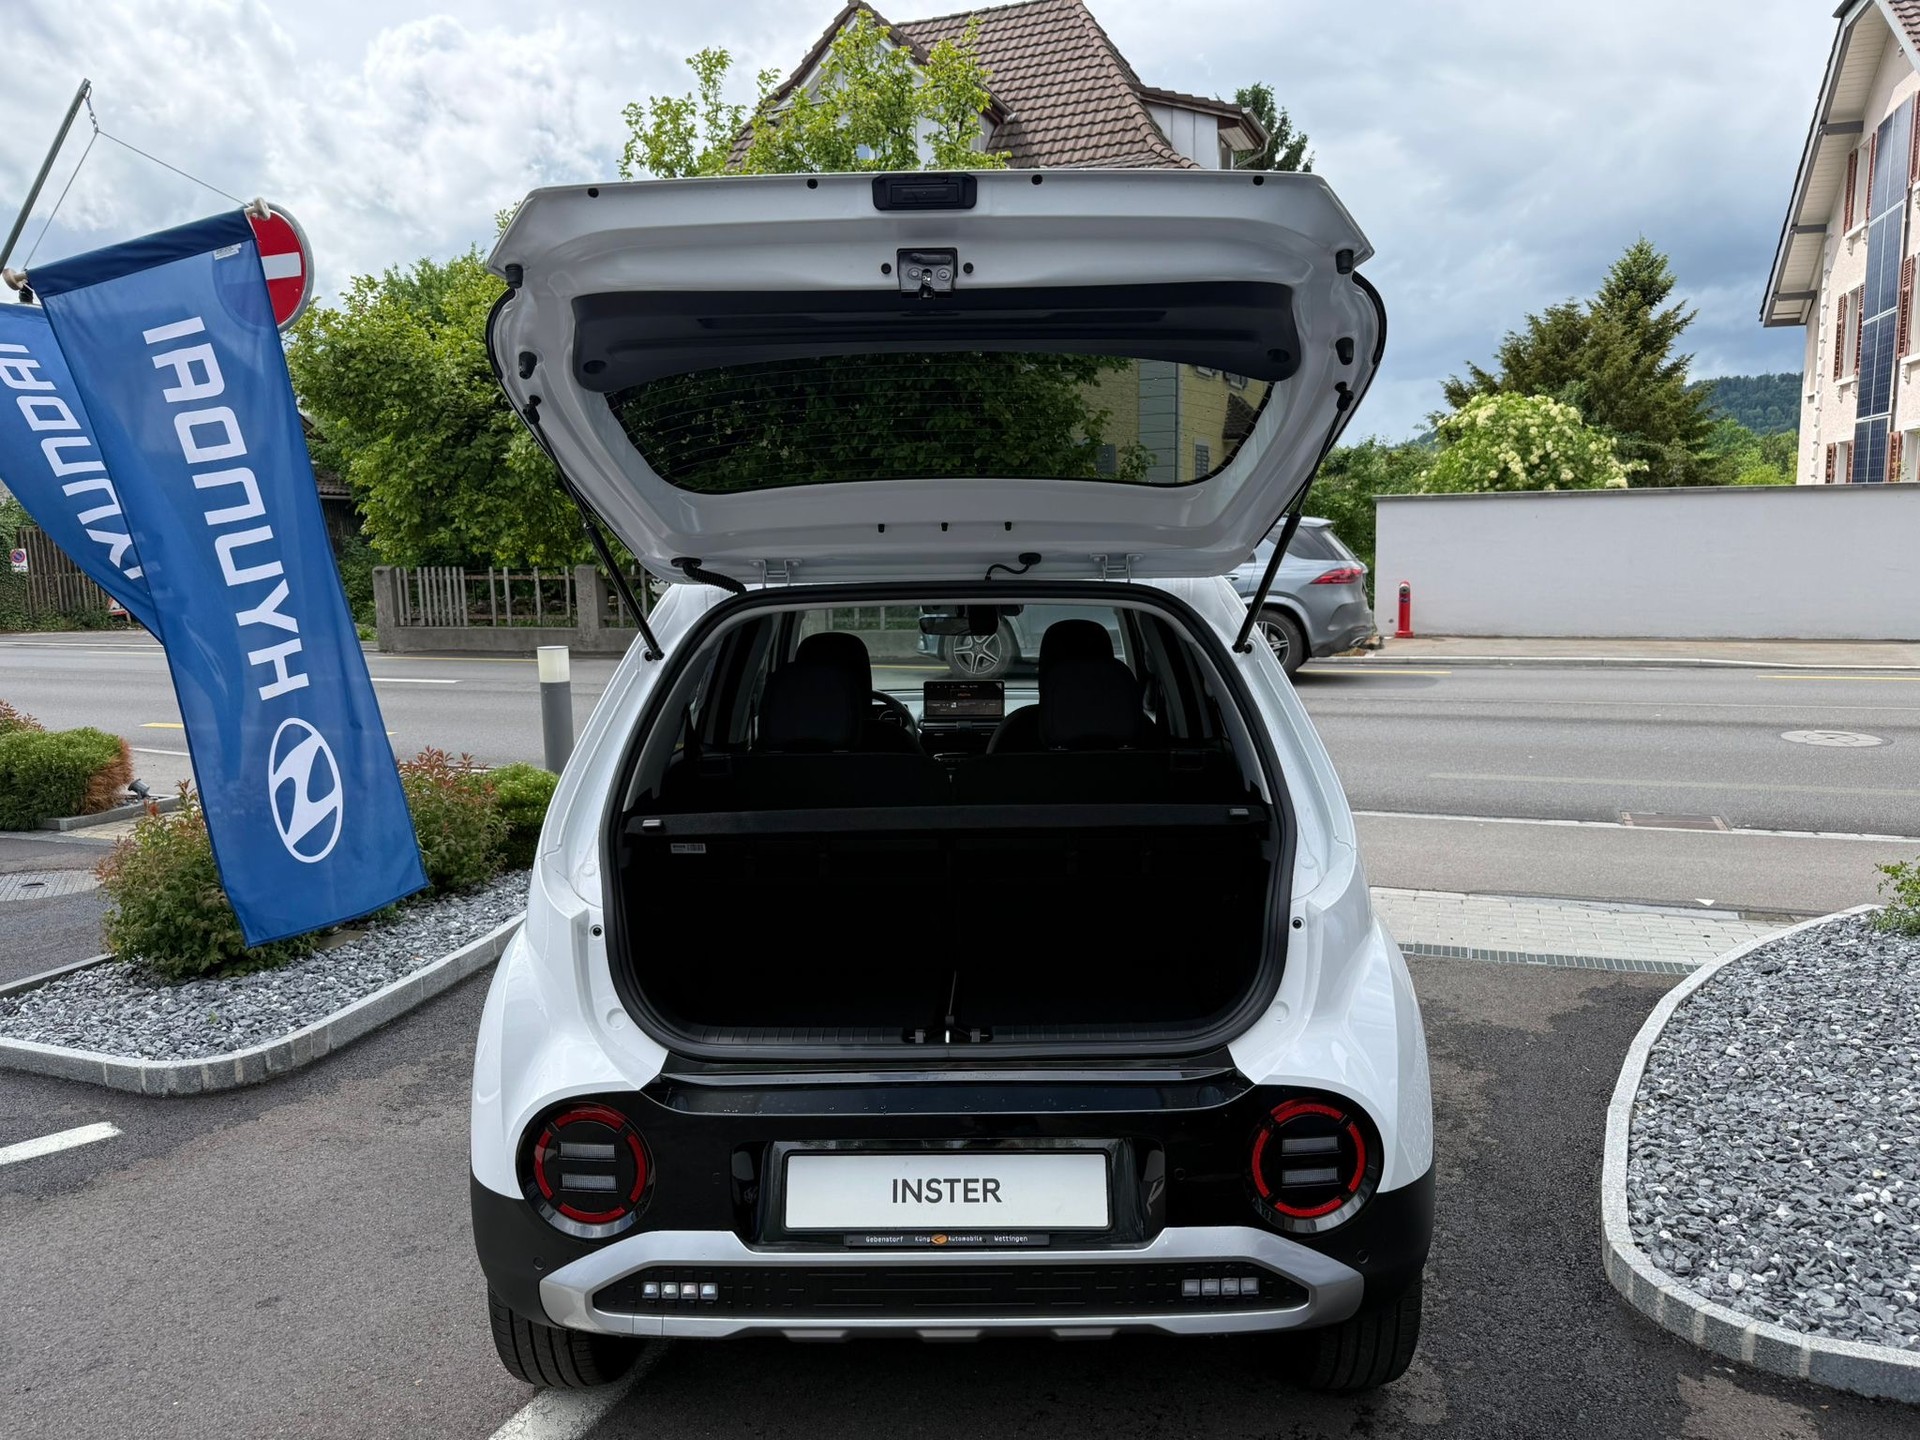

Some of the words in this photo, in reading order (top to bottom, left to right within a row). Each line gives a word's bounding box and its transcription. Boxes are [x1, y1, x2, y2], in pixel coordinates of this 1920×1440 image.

[0, 343, 143, 580] YUNDAI
[892, 1178, 1002, 1204] INSTER
[993, 1235, 1028, 1243] Wettingen
